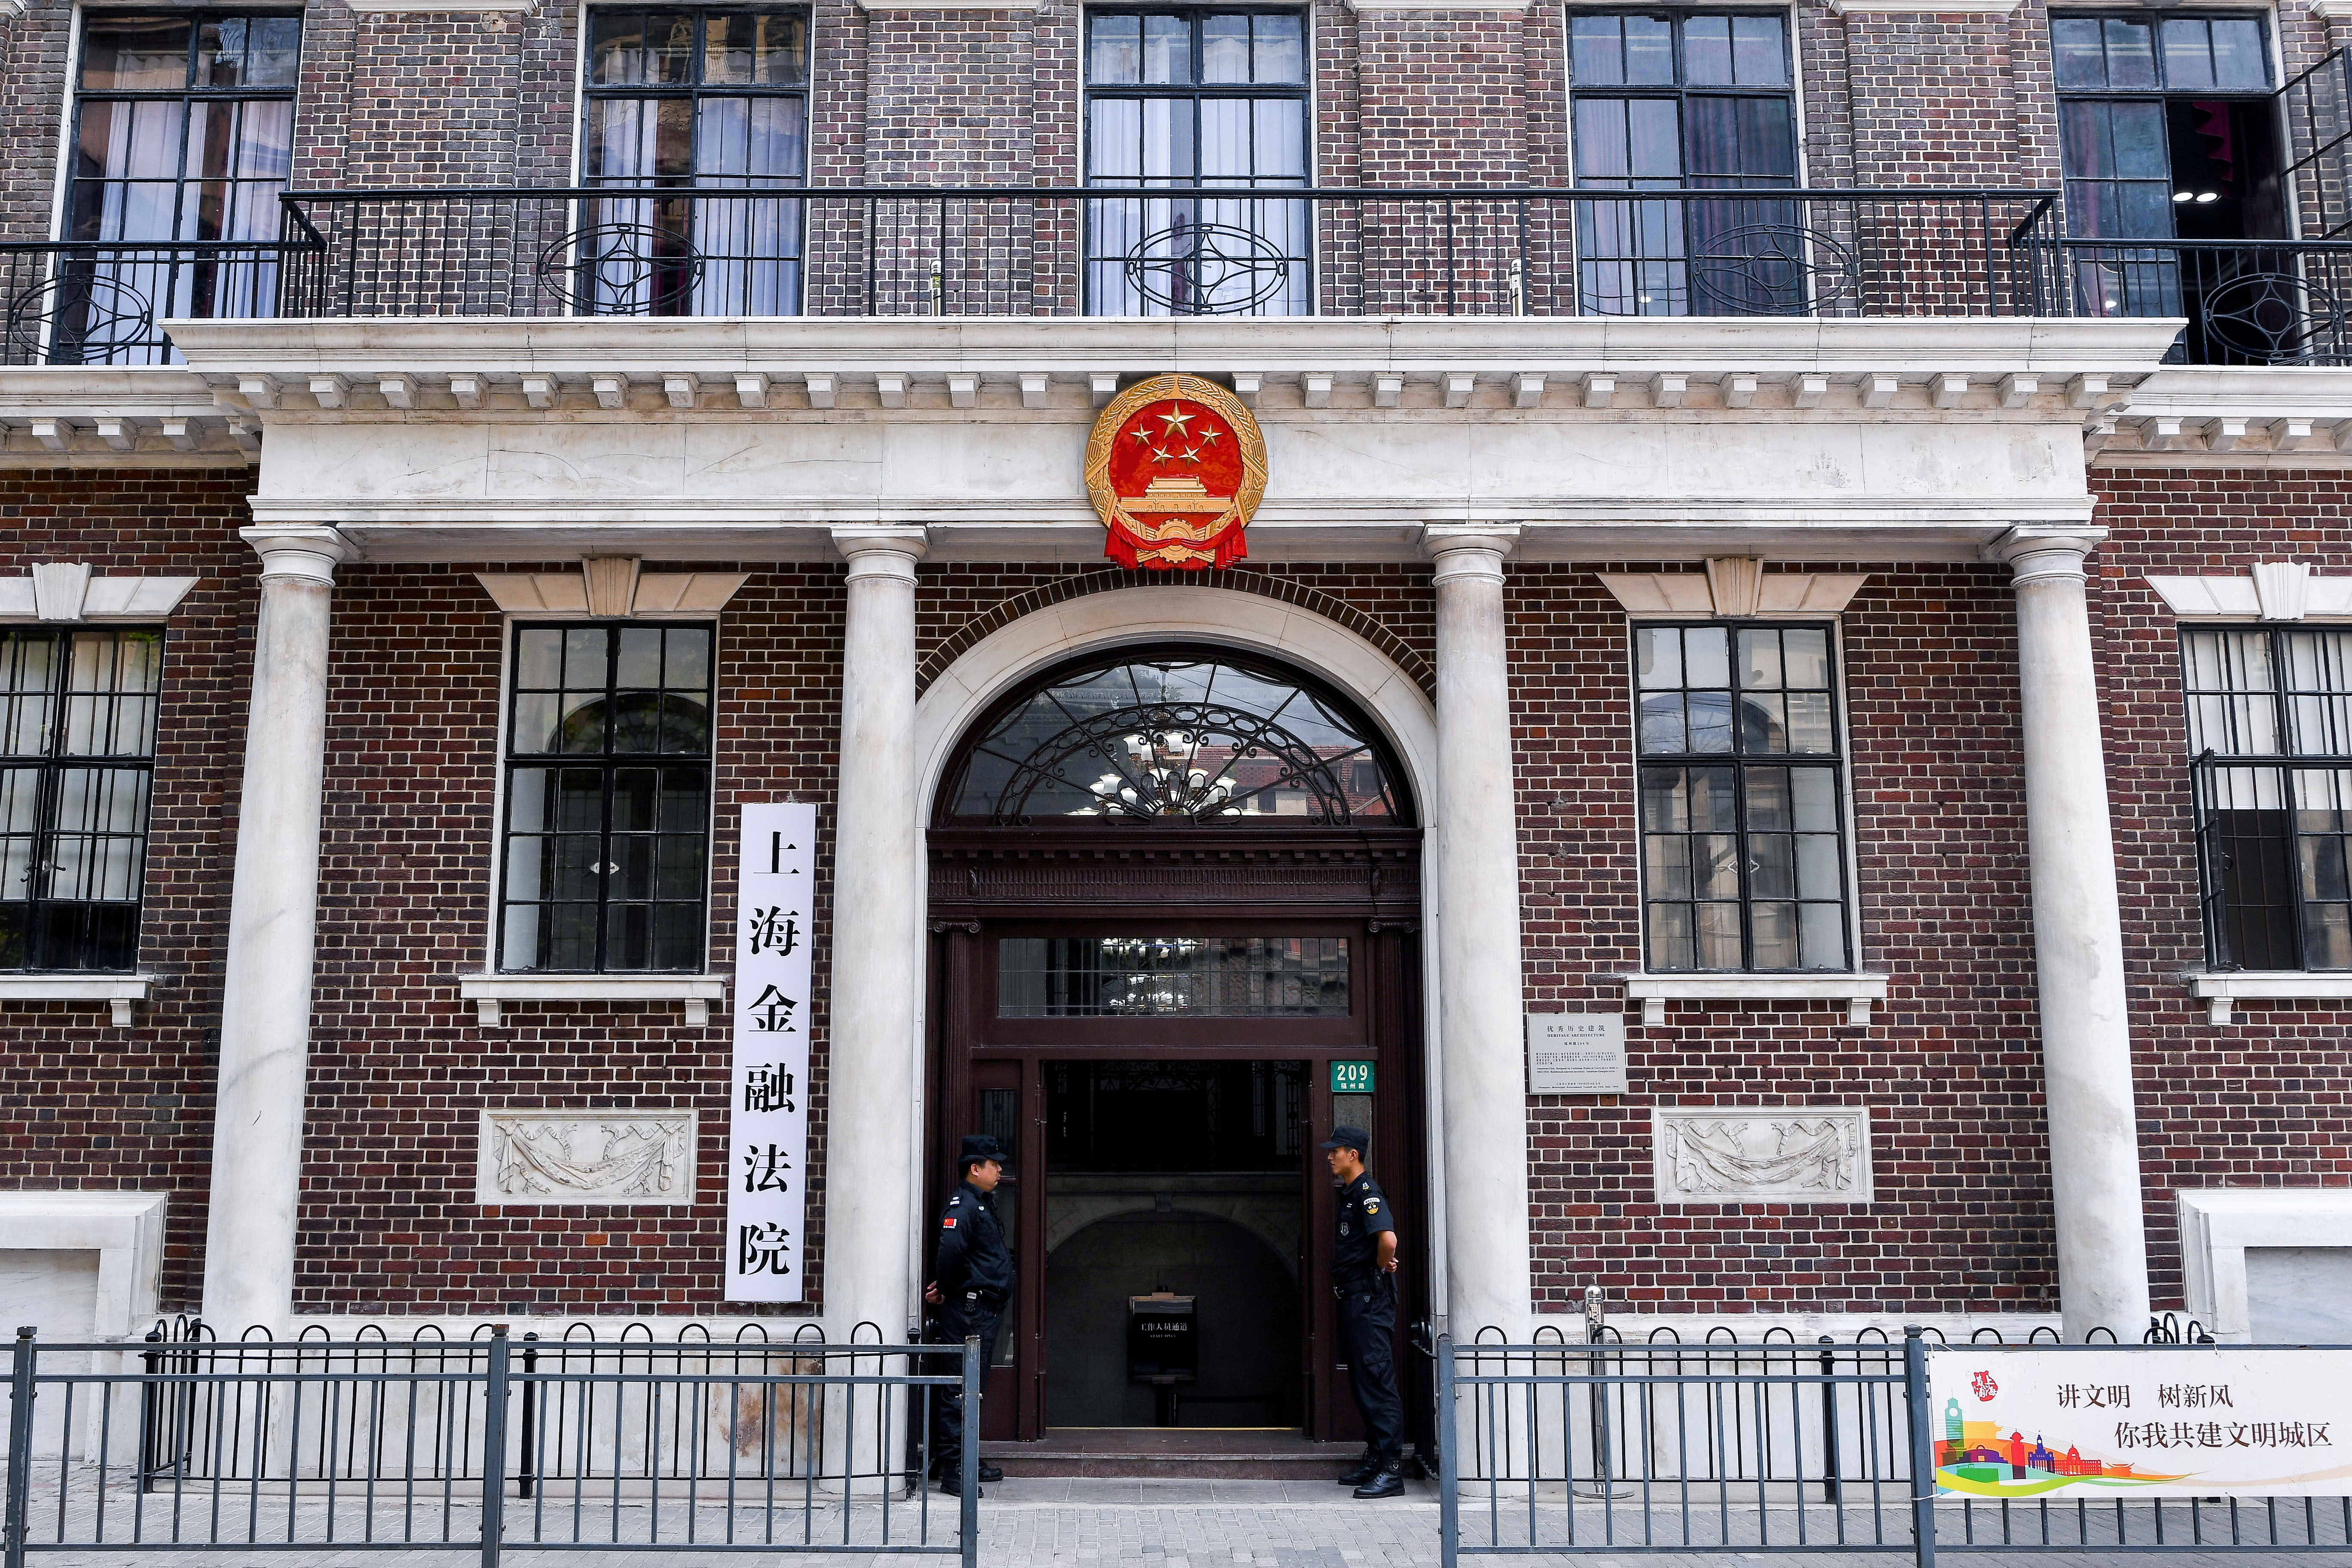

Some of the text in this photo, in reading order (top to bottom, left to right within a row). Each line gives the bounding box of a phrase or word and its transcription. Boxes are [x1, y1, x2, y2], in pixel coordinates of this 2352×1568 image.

[738, 831, 801, 1276] 上海金融法院
[1337, 1065, 1368, 1081] 209
[1141, 1323, 1187, 1331] 工作人员通道
[2057, 1384, 2234, 1409] 讲文明 树新风
[2114, 1421, 2333, 1449] 你我共建文明城区
